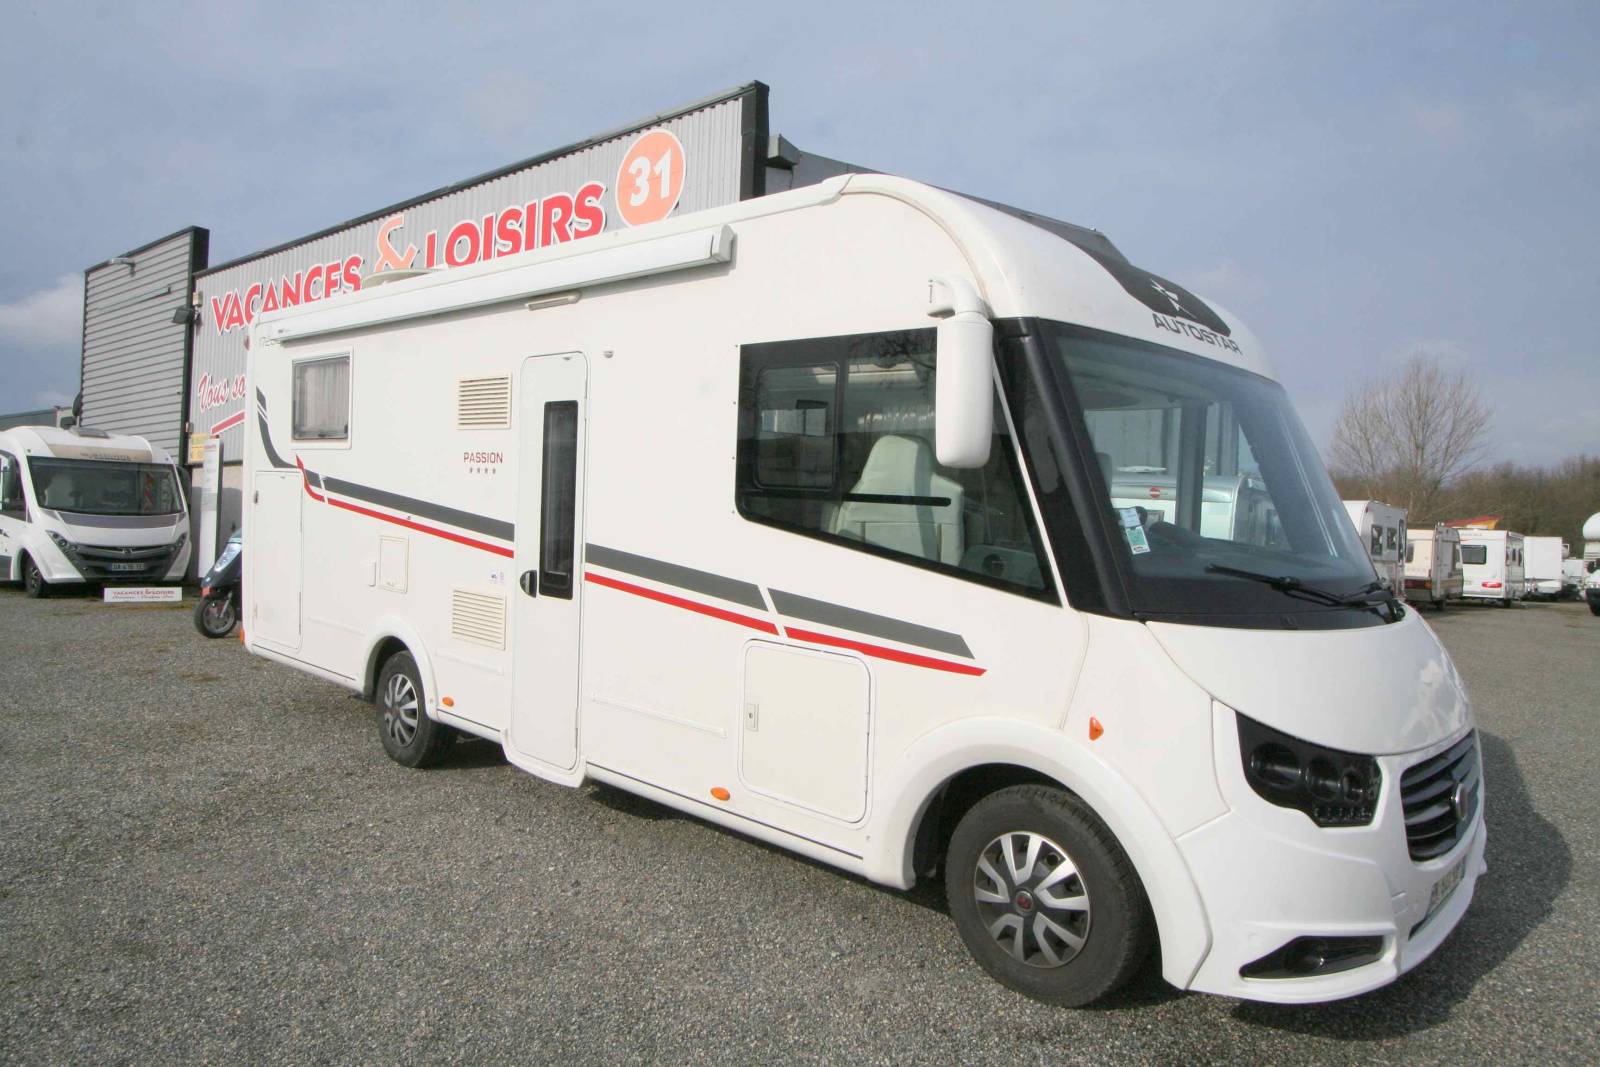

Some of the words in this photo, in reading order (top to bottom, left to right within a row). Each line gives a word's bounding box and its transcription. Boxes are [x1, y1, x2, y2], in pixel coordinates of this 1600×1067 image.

[628, 148, 672, 207] 31
[212, 255, 363, 335] VACANCES
[425, 182, 607, 268] LOISIRS
[1152, 314, 1243, 355] AUTOSTAR
[198, 373, 229, 413] Vous
[463, 451, 503, 464] PASSION
